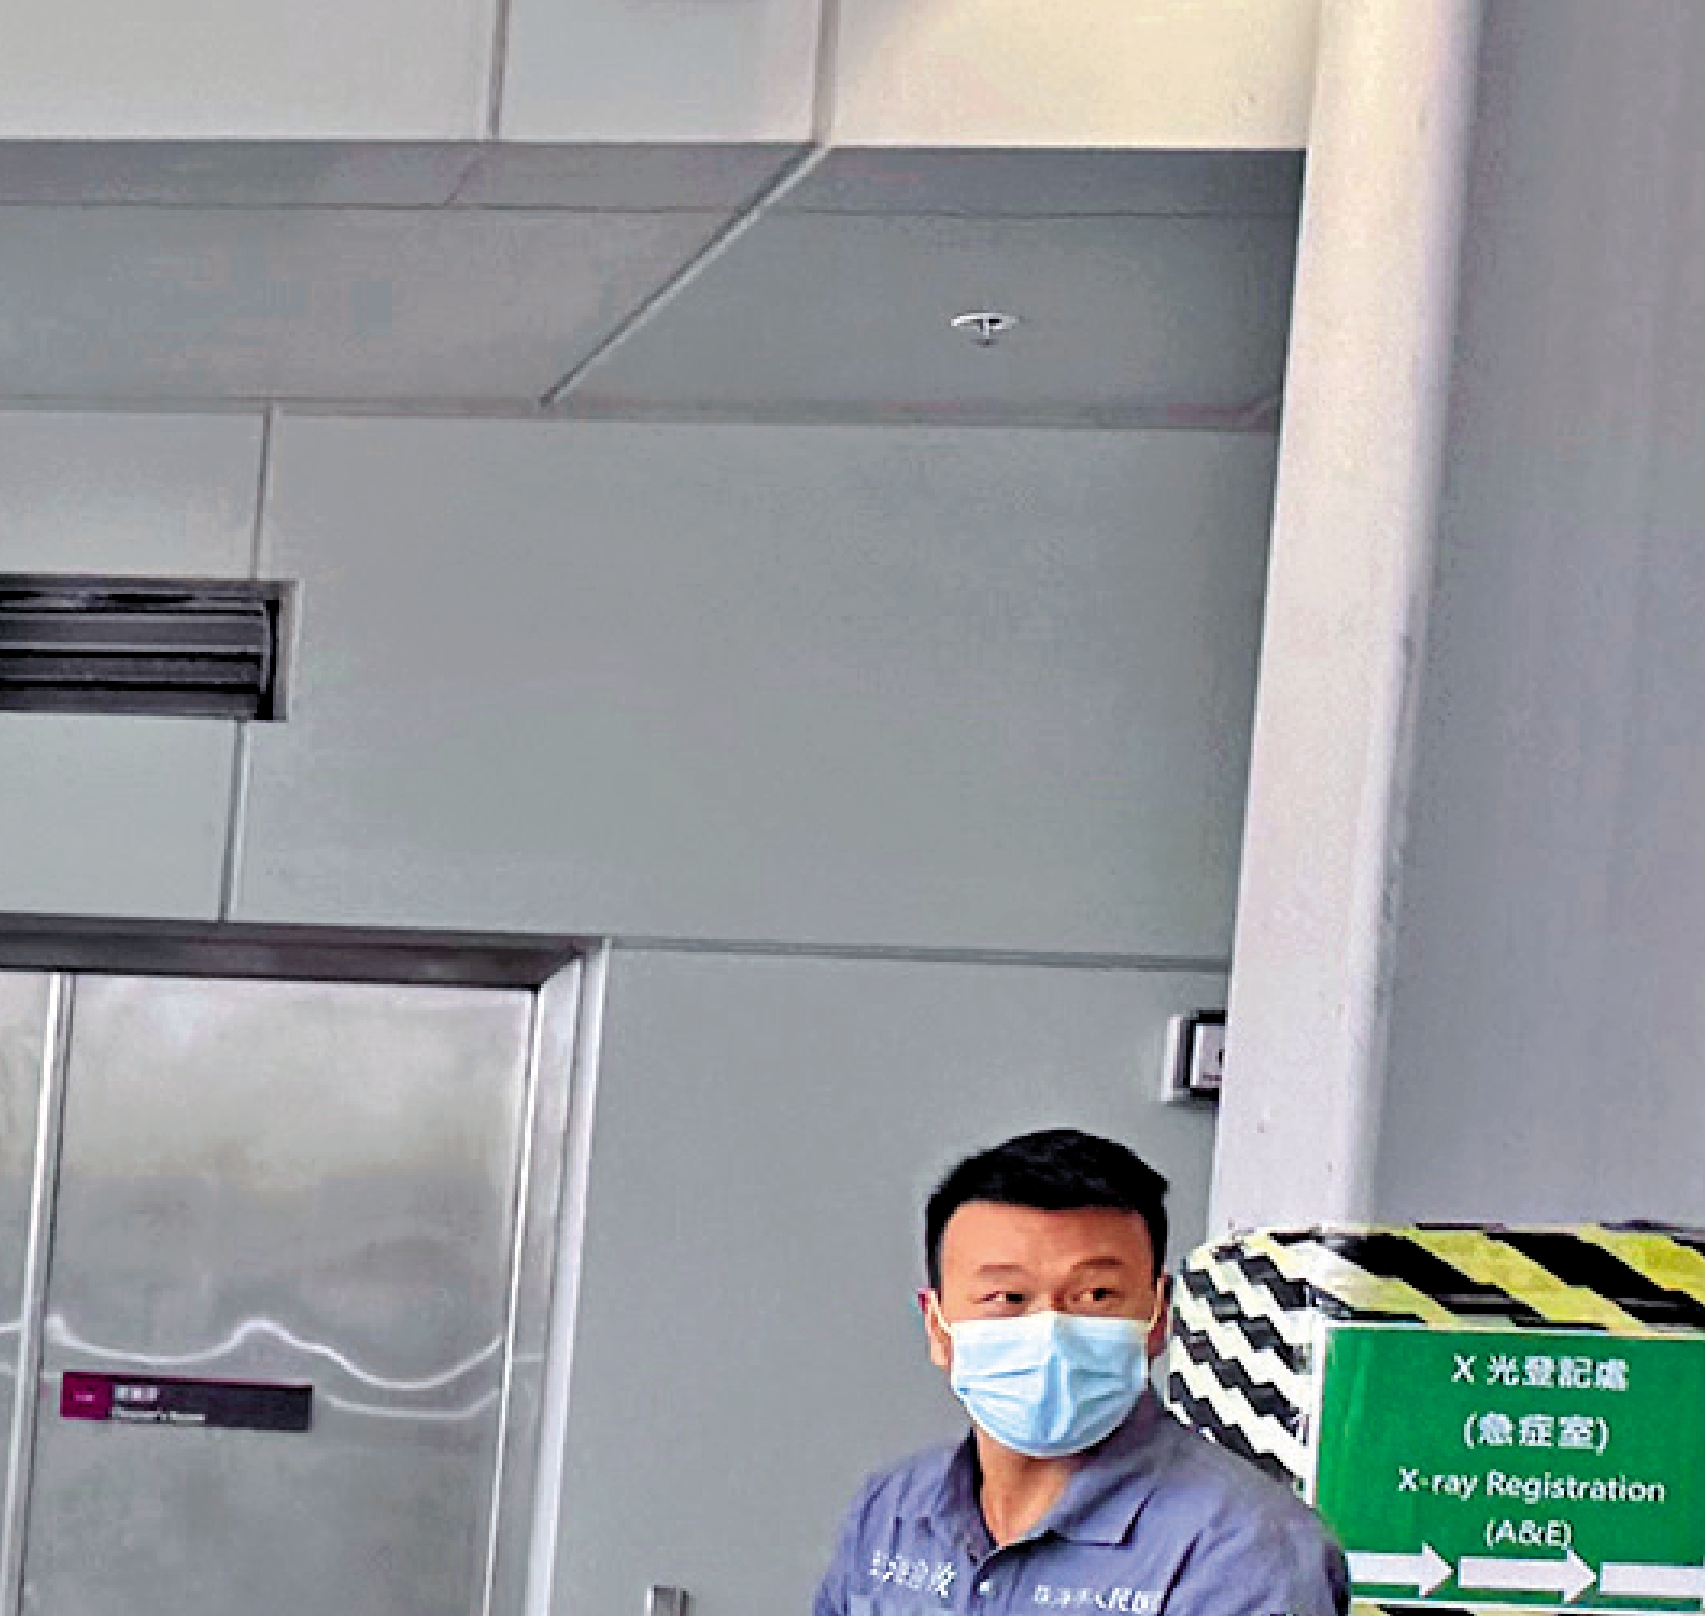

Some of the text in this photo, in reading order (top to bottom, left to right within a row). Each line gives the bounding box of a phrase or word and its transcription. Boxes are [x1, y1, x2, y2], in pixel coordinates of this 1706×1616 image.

[1398, 1468, 1665, 1503] X-ray Registration
[1486, 1519, 1572, 1549] (A&E)
